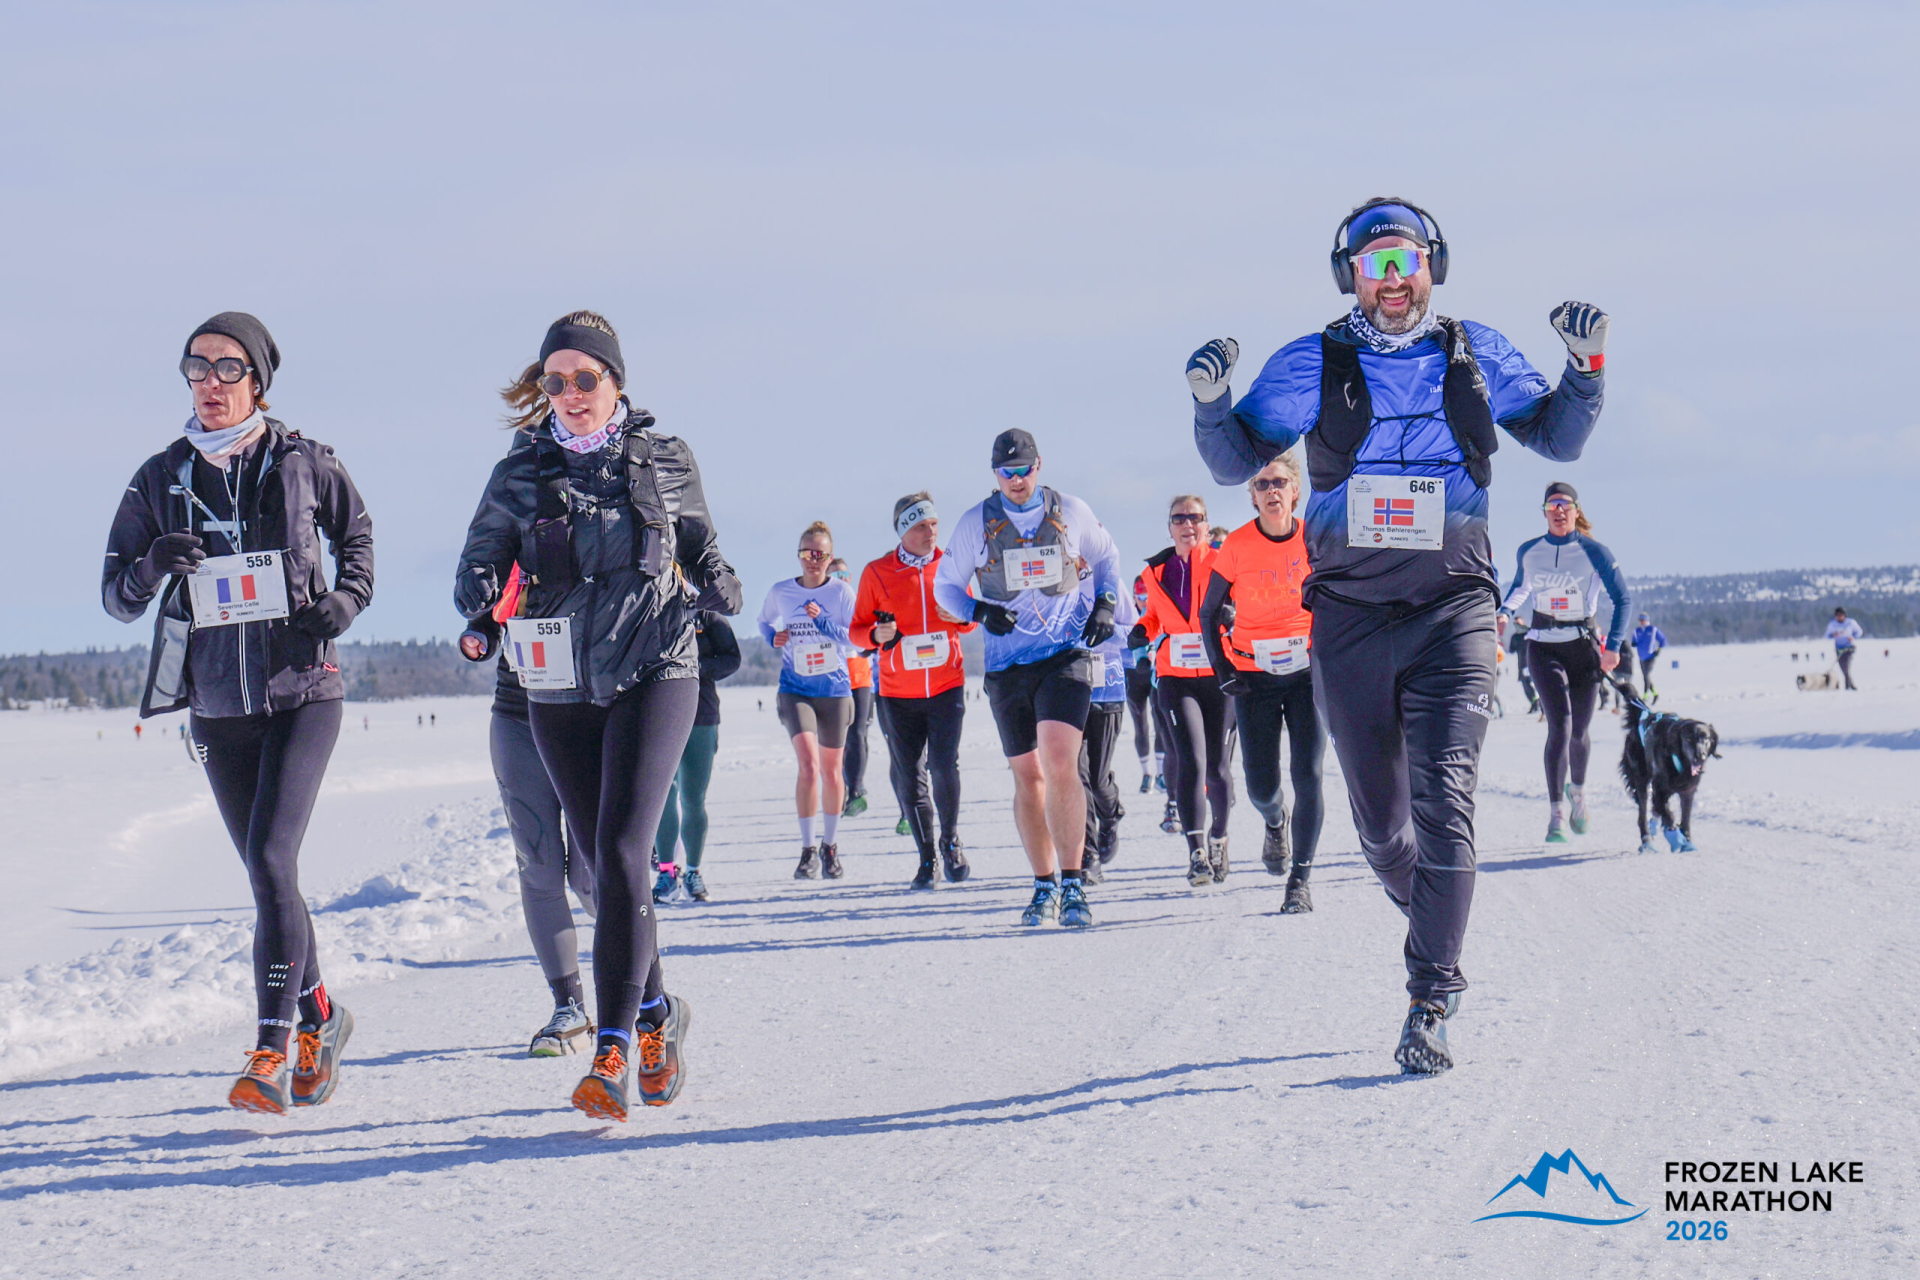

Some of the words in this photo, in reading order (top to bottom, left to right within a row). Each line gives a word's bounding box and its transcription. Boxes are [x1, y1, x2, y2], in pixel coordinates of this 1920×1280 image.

[1381, 223, 1416, 236] ISACHSEN
[1409, 480, 1435, 494] 646
[1362, 525, 1385, 533] Thomas
[1040, 548, 1055, 557] 626
[246, 554, 272, 568] 558
[217, 602, 243, 611] Severine
[244, 601, 260, 609] Celle
[537, 622, 561, 635] 559
[930, 633, 943, 641] 545
[1288, 638, 1303, 647] 563
